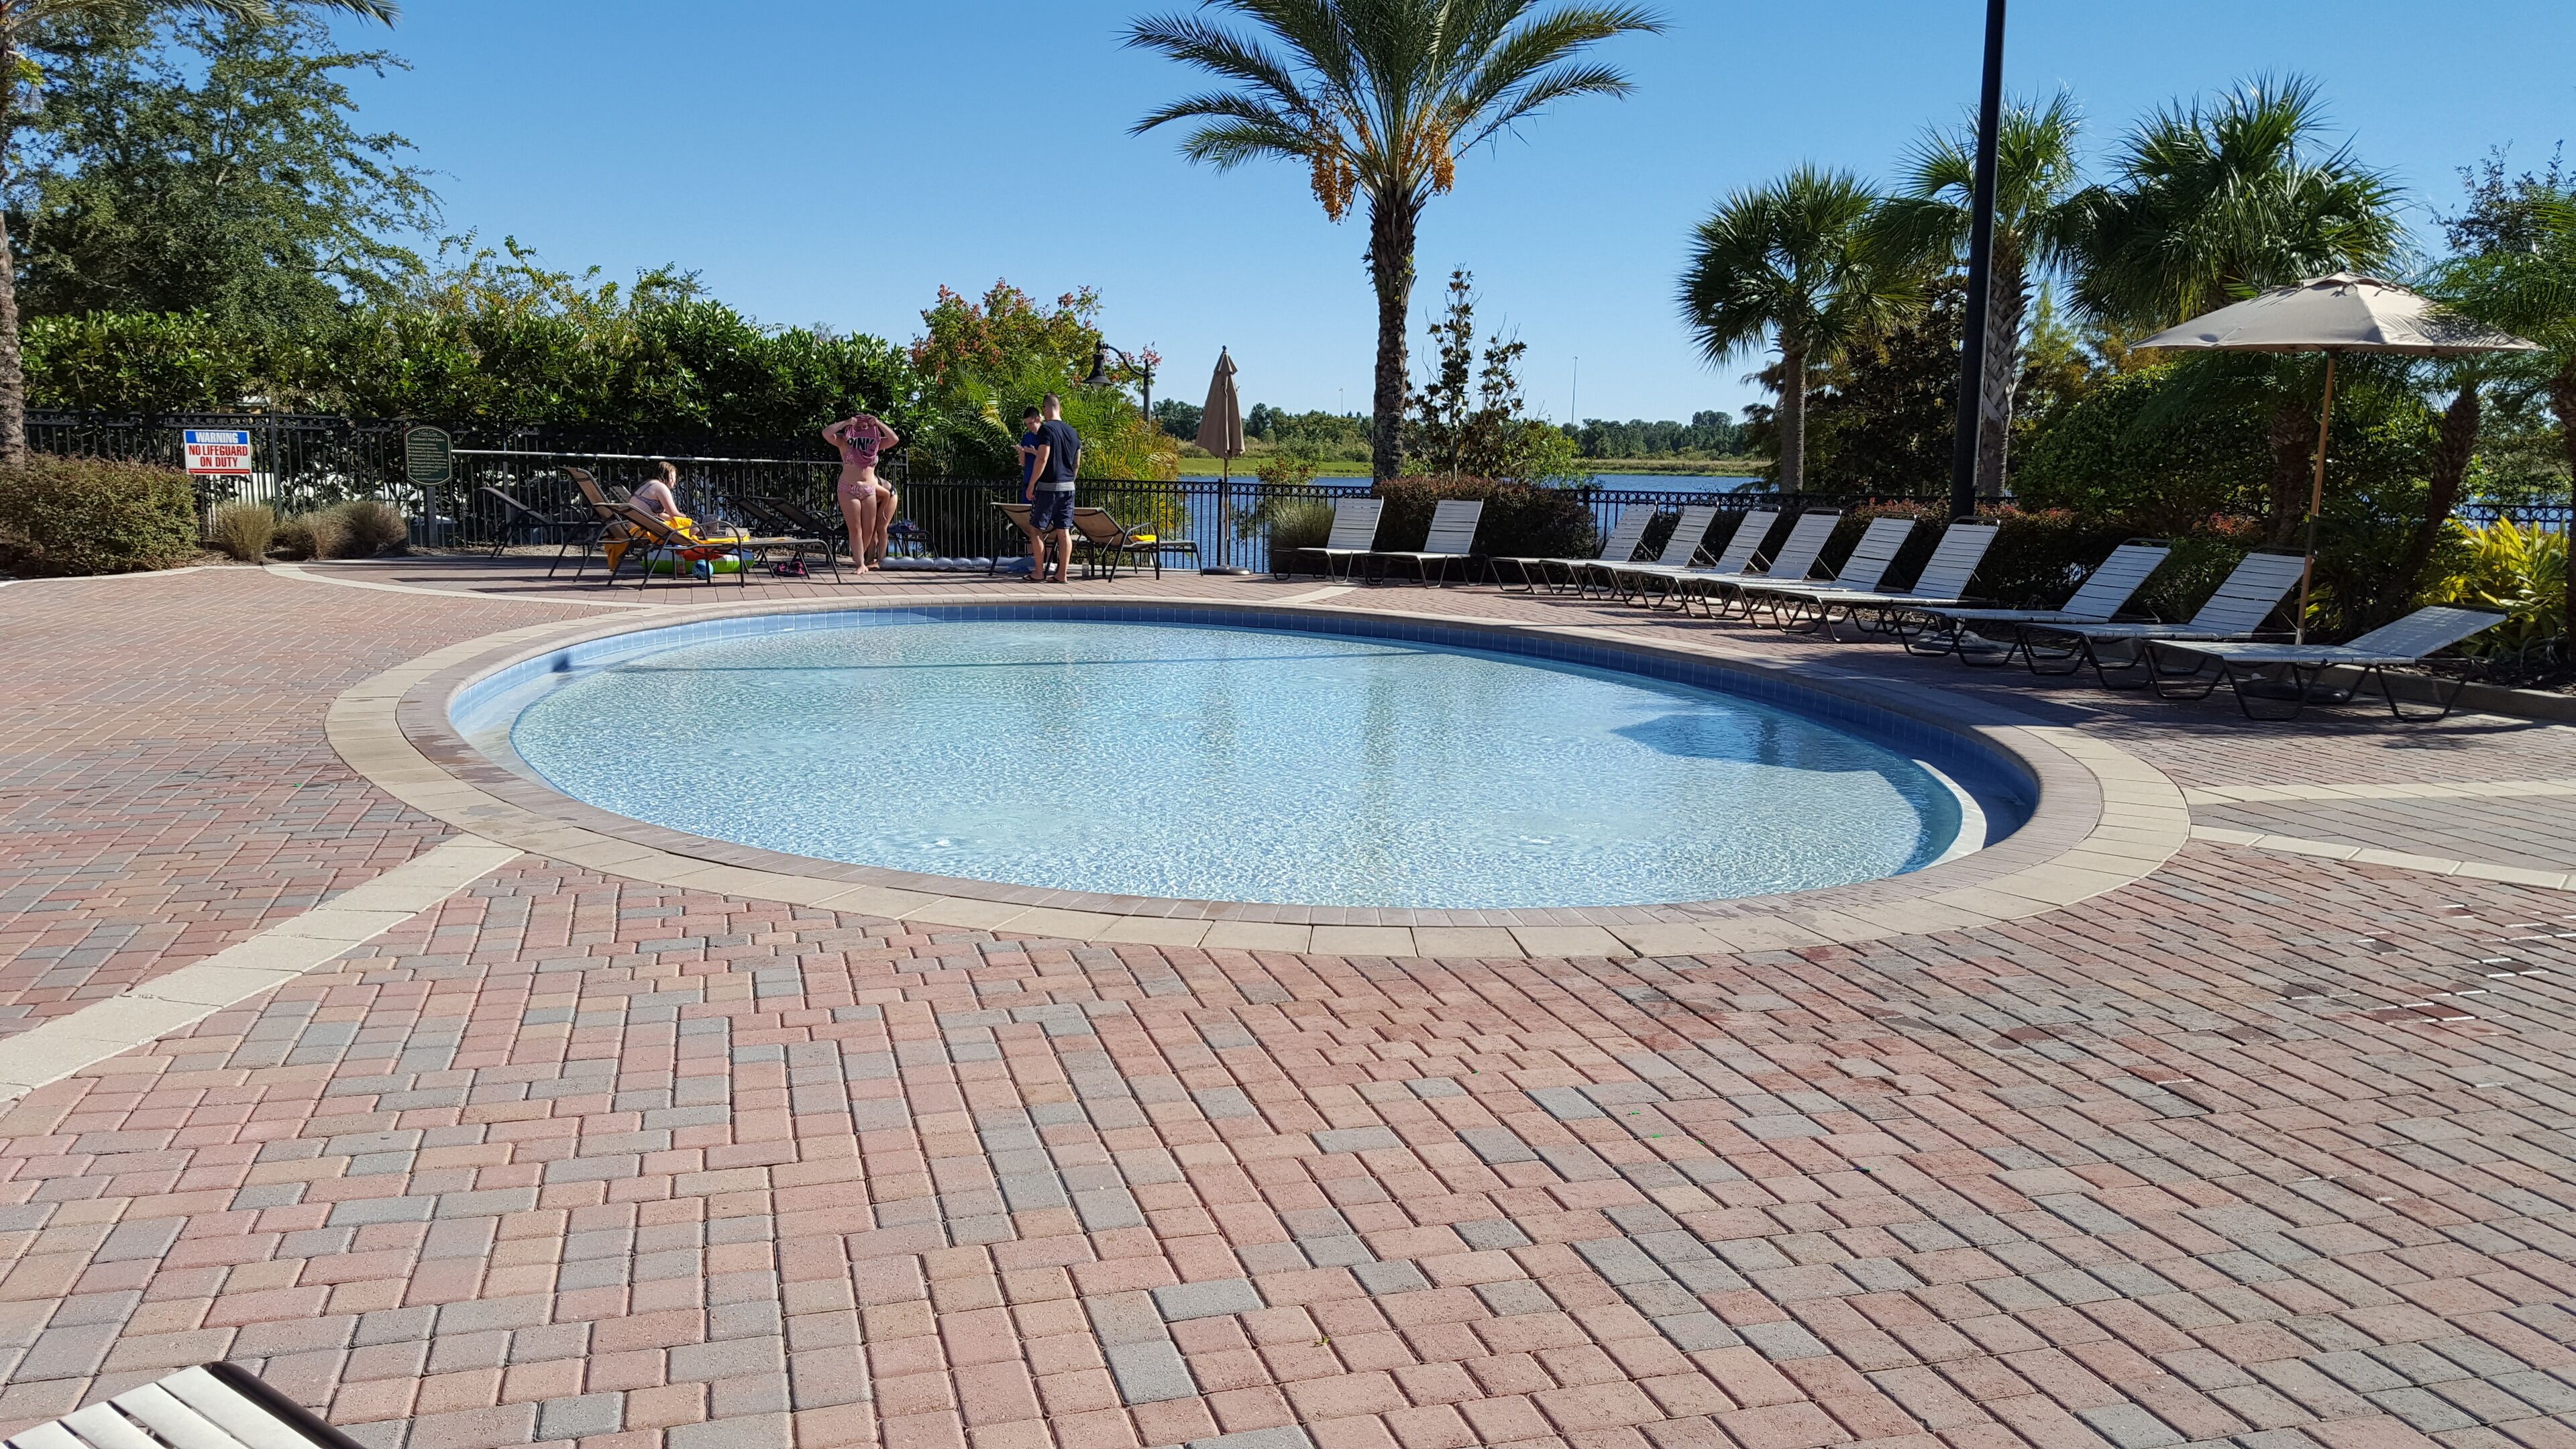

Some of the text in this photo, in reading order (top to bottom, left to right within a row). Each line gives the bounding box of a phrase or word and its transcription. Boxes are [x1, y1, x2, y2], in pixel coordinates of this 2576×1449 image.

[195, 432, 238, 443] WARNING
[189, 445, 248, 456] NO LIFEGUARD
[200, 457, 237, 467] ON DUTY
